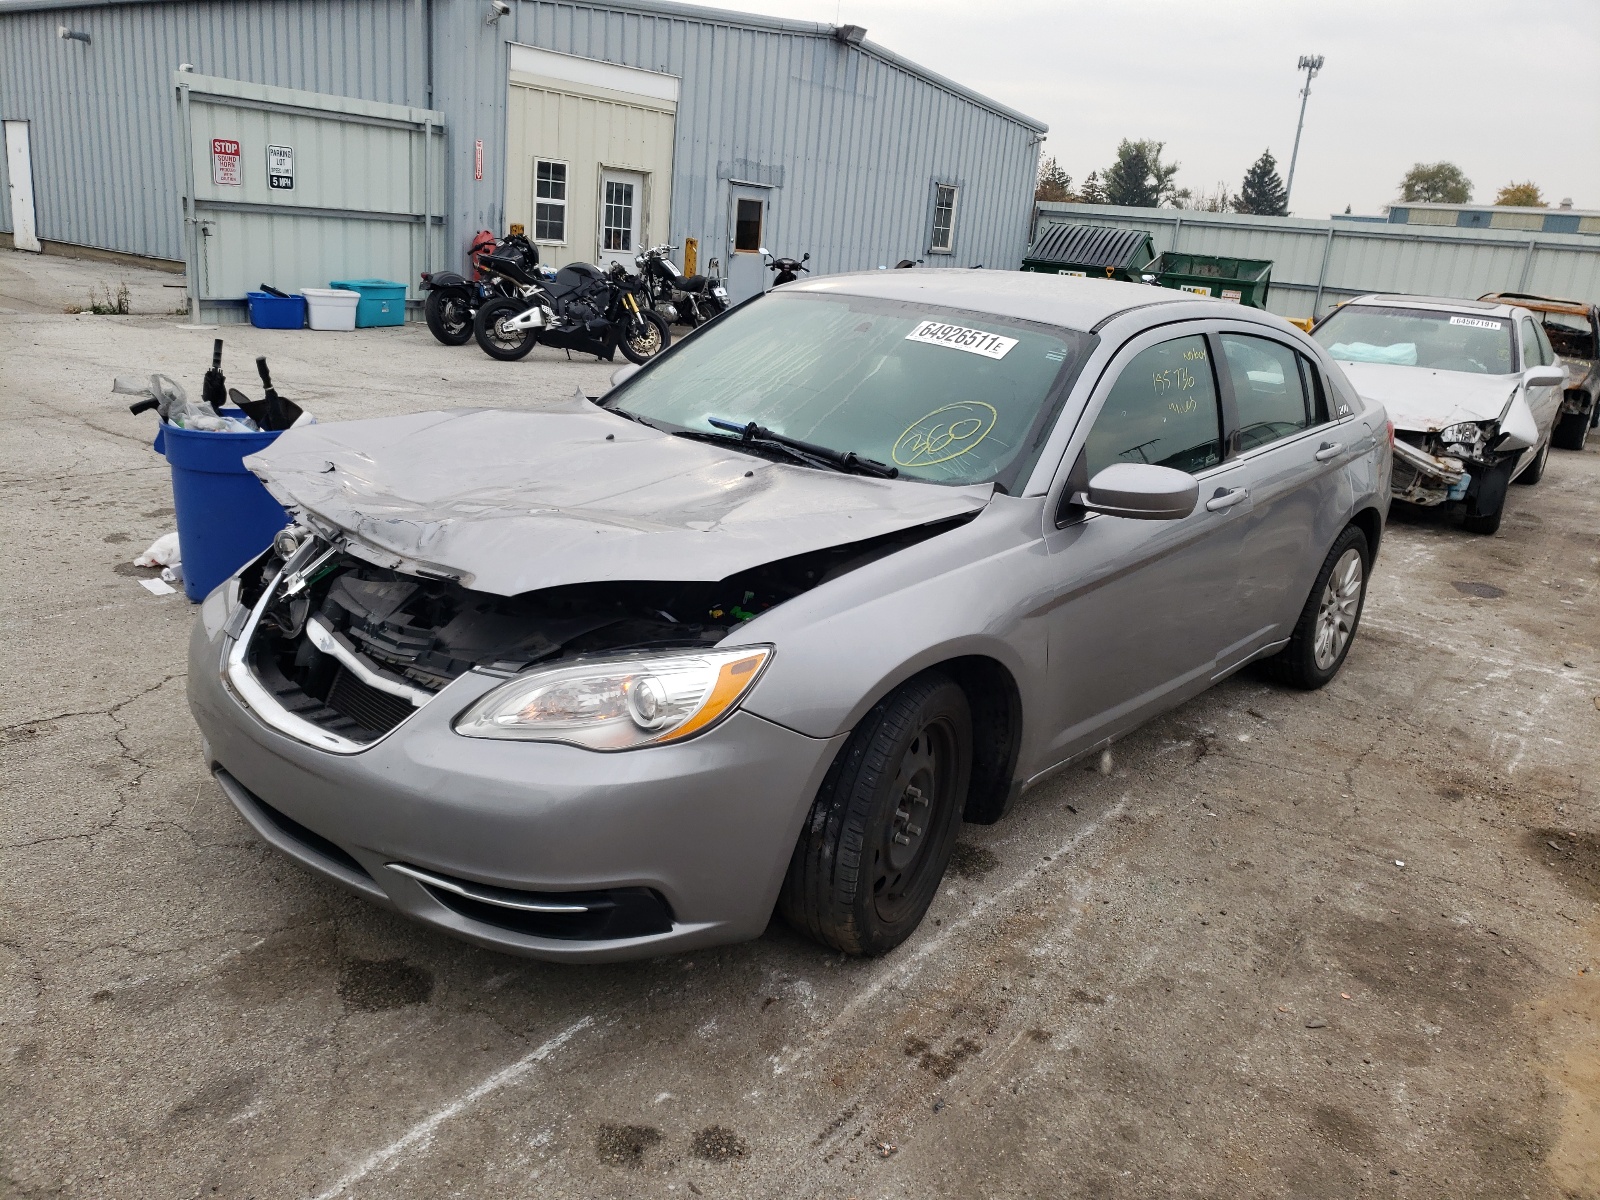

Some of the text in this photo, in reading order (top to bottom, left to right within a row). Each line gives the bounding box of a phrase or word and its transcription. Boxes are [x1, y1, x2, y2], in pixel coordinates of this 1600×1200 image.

[215, 142, 237, 153] STOP
[270, 149, 291, 158] PARKING
[272, 177, 291, 187] 5 MPH
